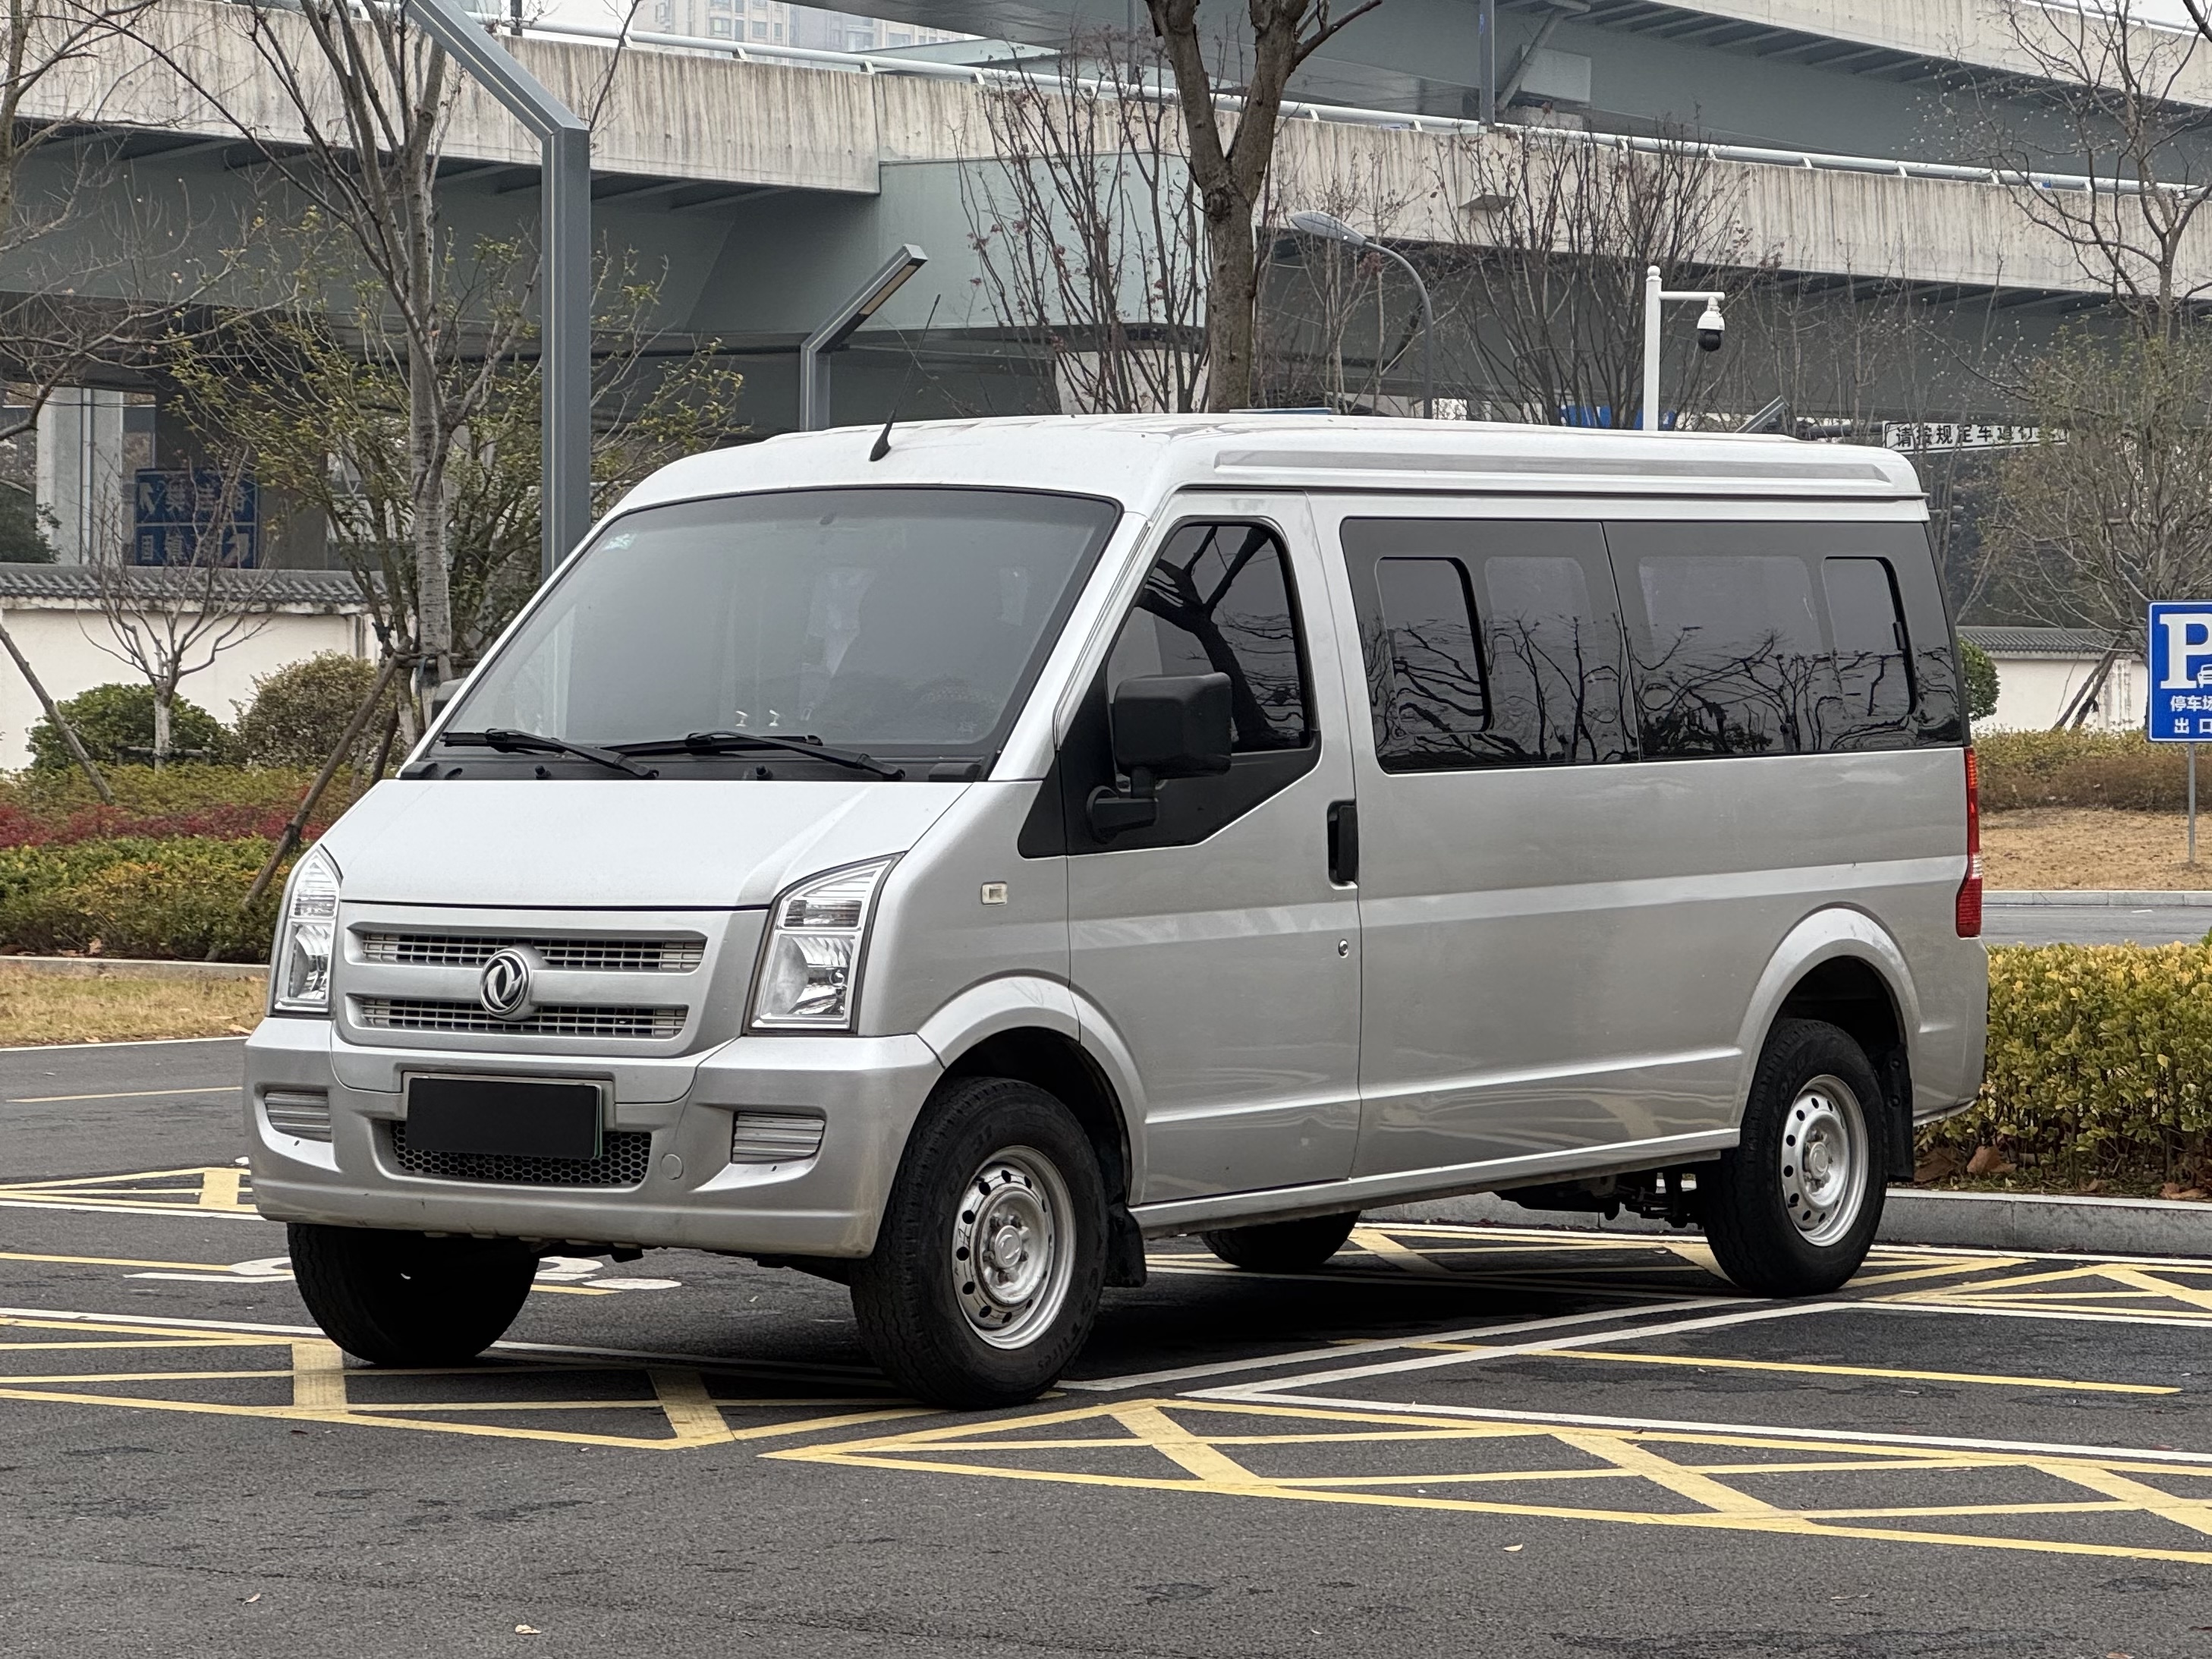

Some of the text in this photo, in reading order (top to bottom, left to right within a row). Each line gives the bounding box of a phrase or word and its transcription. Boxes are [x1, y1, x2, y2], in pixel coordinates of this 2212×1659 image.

[2159, 613, 2212, 689] P
[2170, 695, 2212, 712] 停车场
[2174, 717, 2212, 734] 出口
